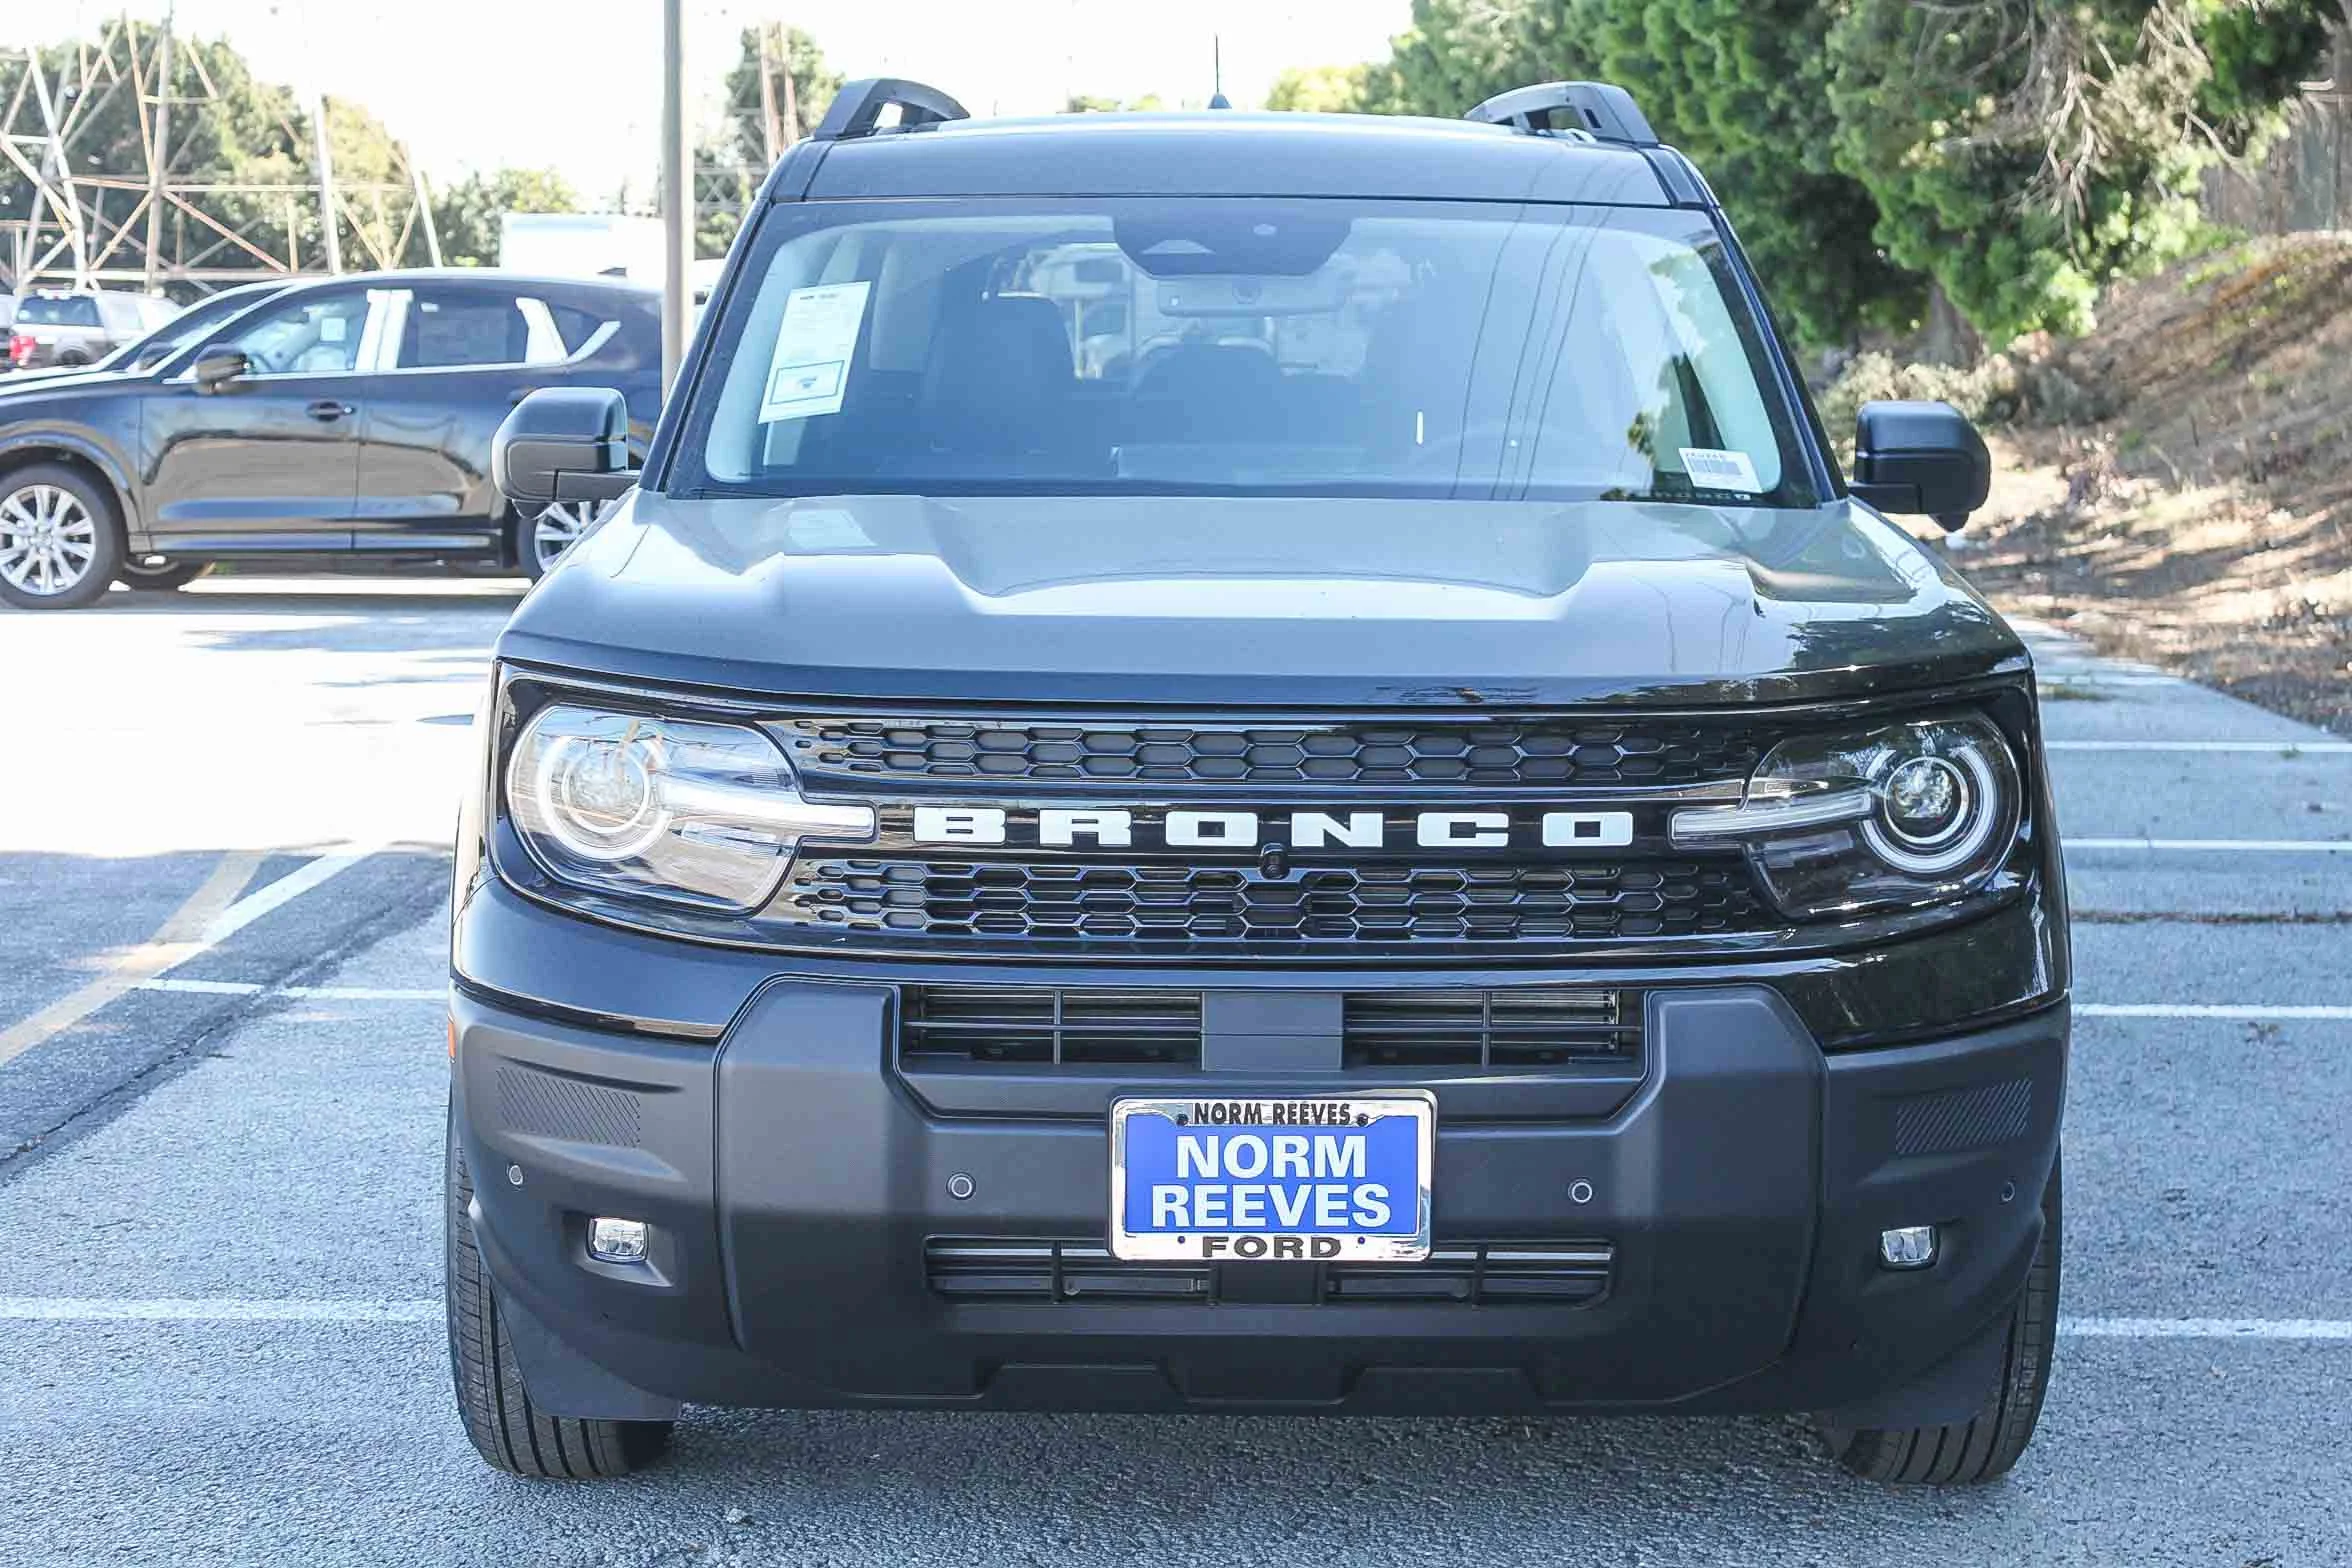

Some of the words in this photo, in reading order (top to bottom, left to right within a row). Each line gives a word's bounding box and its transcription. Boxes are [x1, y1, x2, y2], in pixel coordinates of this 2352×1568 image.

[912, 806, 1634, 848] BRONCO
[1195, 1103, 1263, 1125] NORM
[1273, 1103, 1351, 1126] REEVES
[1176, 1134, 1366, 1179] NORM
[1152, 1183, 1391, 1228] REEVES
[1202, 1235, 1342, 1258] FORD
